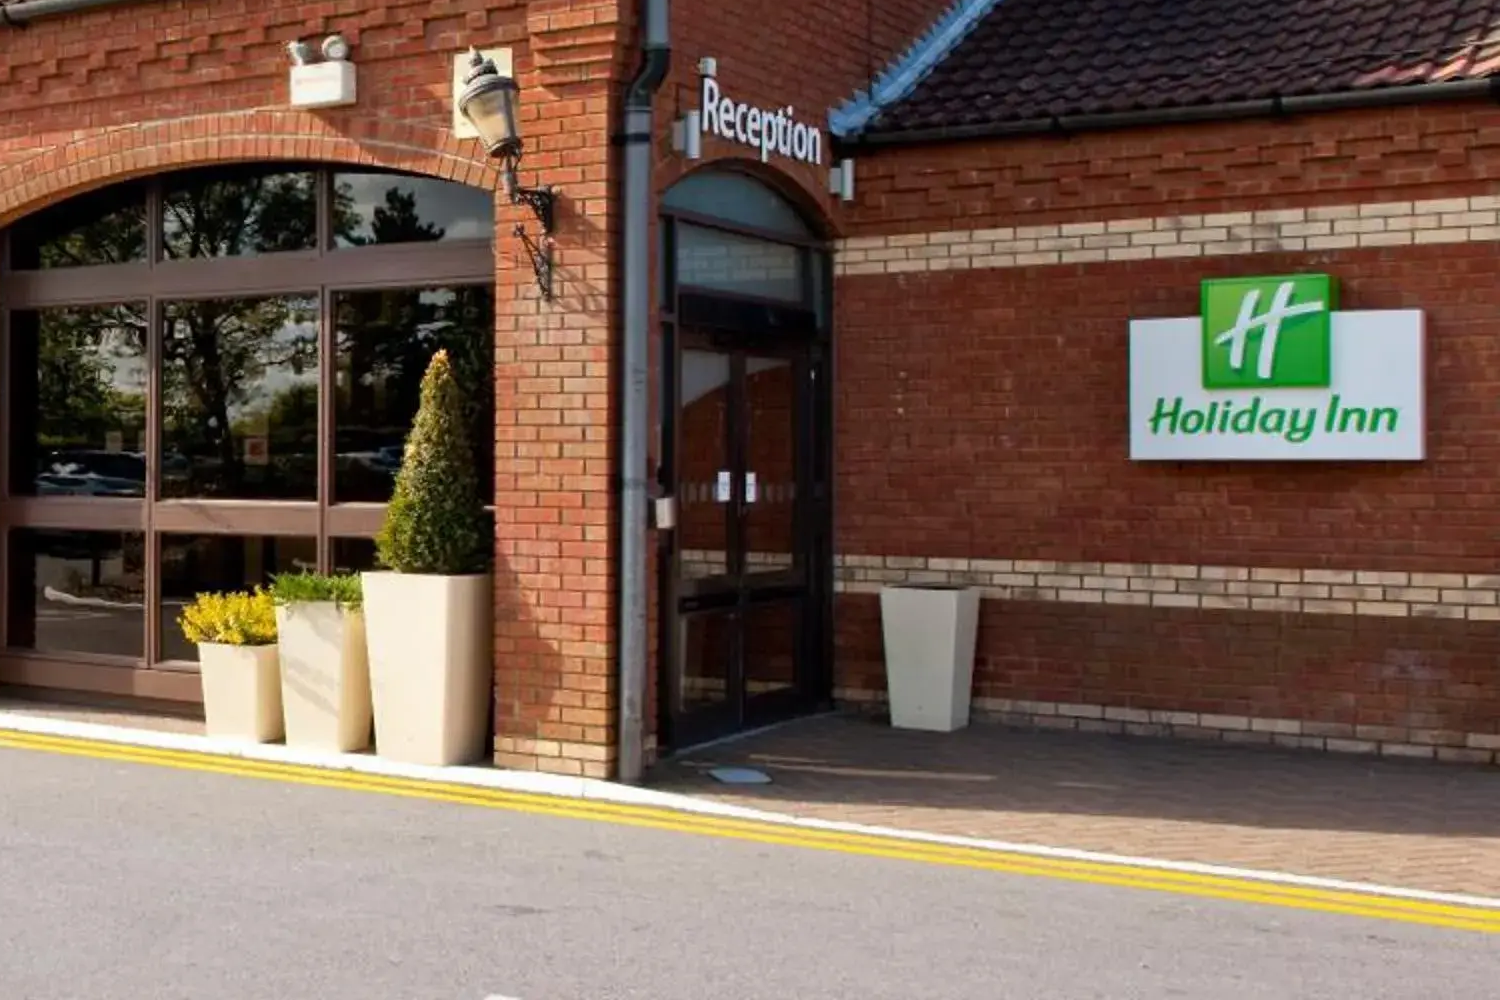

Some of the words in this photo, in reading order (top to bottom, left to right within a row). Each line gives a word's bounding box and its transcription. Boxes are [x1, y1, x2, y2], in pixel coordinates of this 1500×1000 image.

[702, 77, 821, 165] Reception
[1213, 281, 1325, 379] H
[1148, 396, 1318, 444] Holiday
[1323, 393, 1400, 433] Inn
